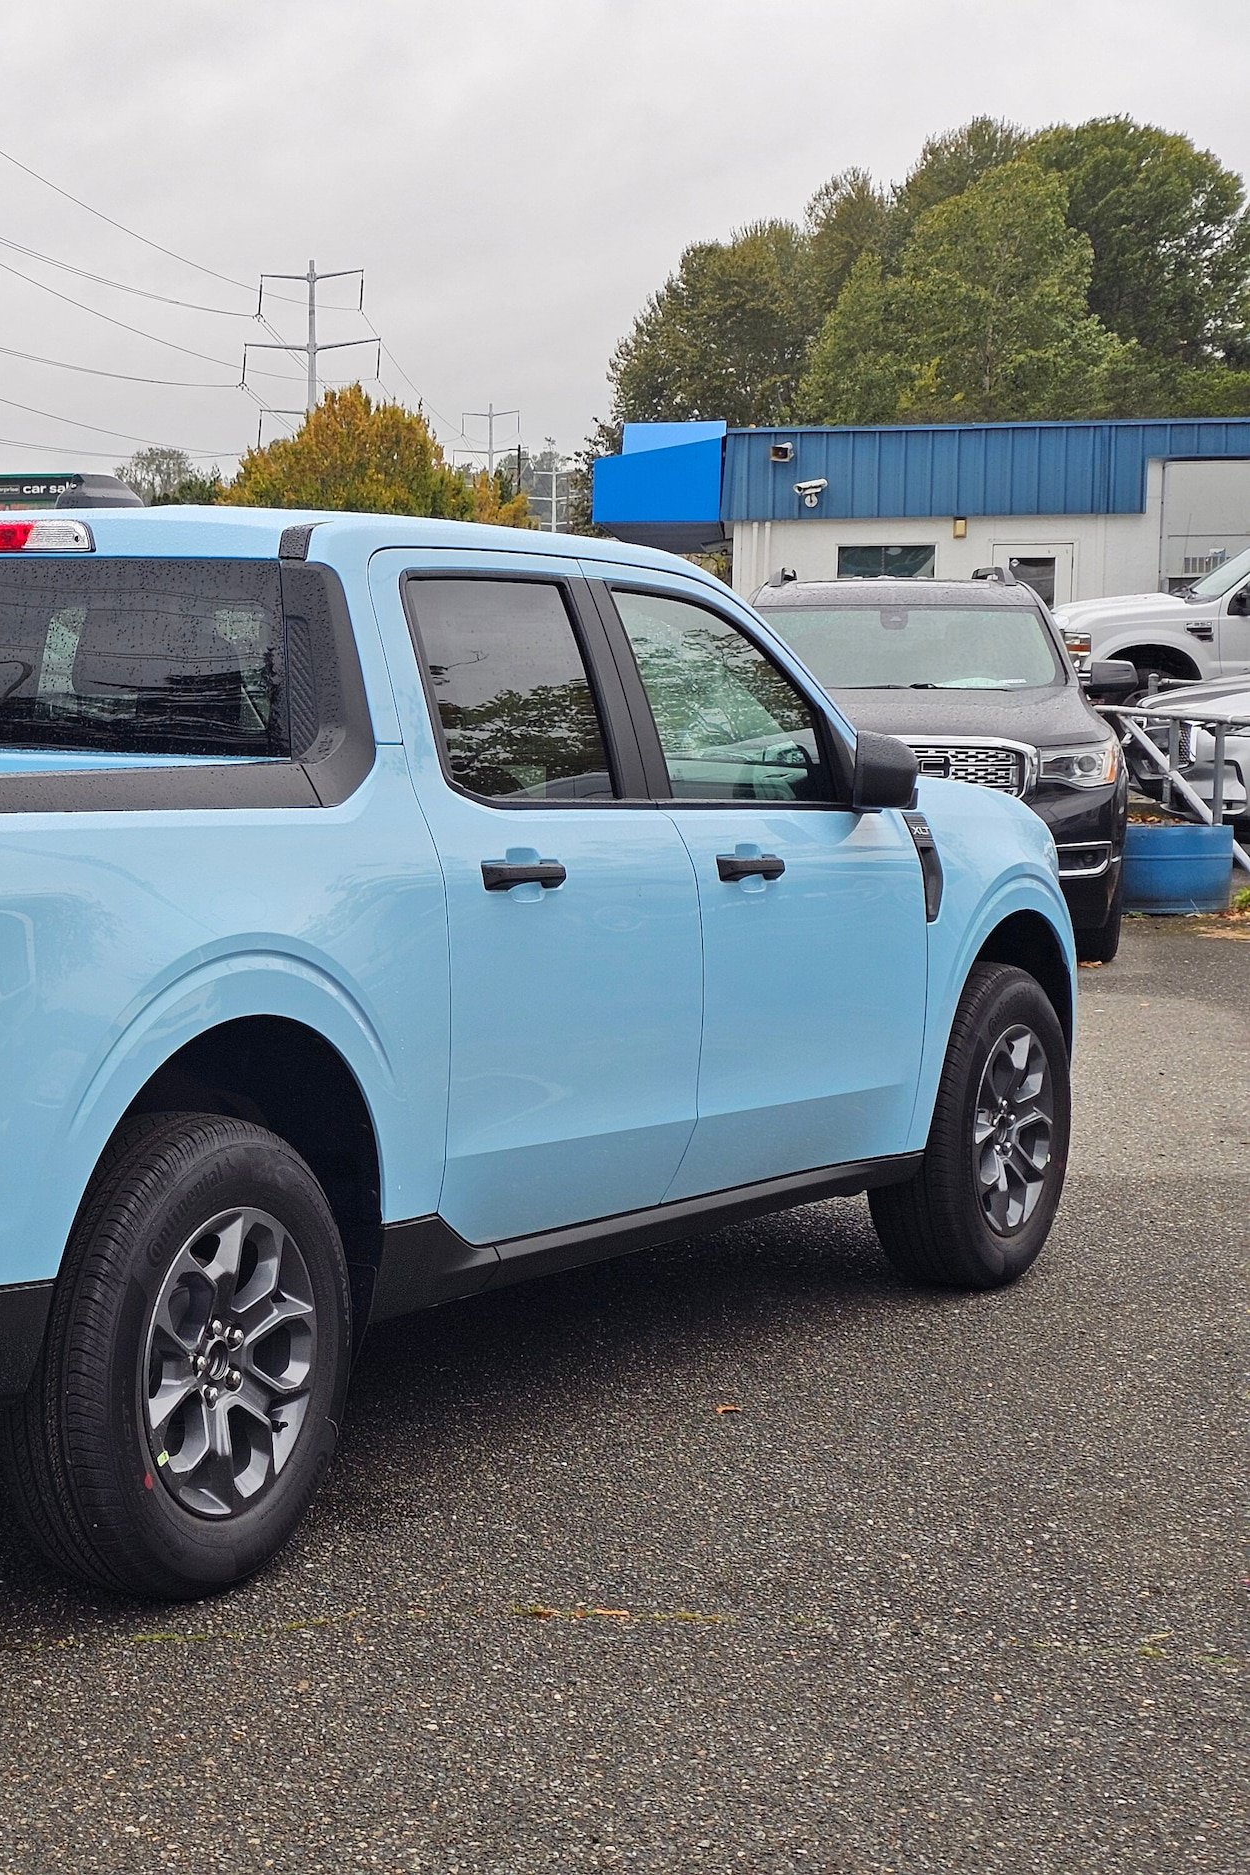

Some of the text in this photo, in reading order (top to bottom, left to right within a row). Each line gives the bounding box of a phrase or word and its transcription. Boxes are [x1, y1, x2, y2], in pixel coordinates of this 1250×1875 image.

[23, 485, 46, 494] car
[911, 826, 930, 836] XLT
[147, 1160, 224, 1268] Continental
